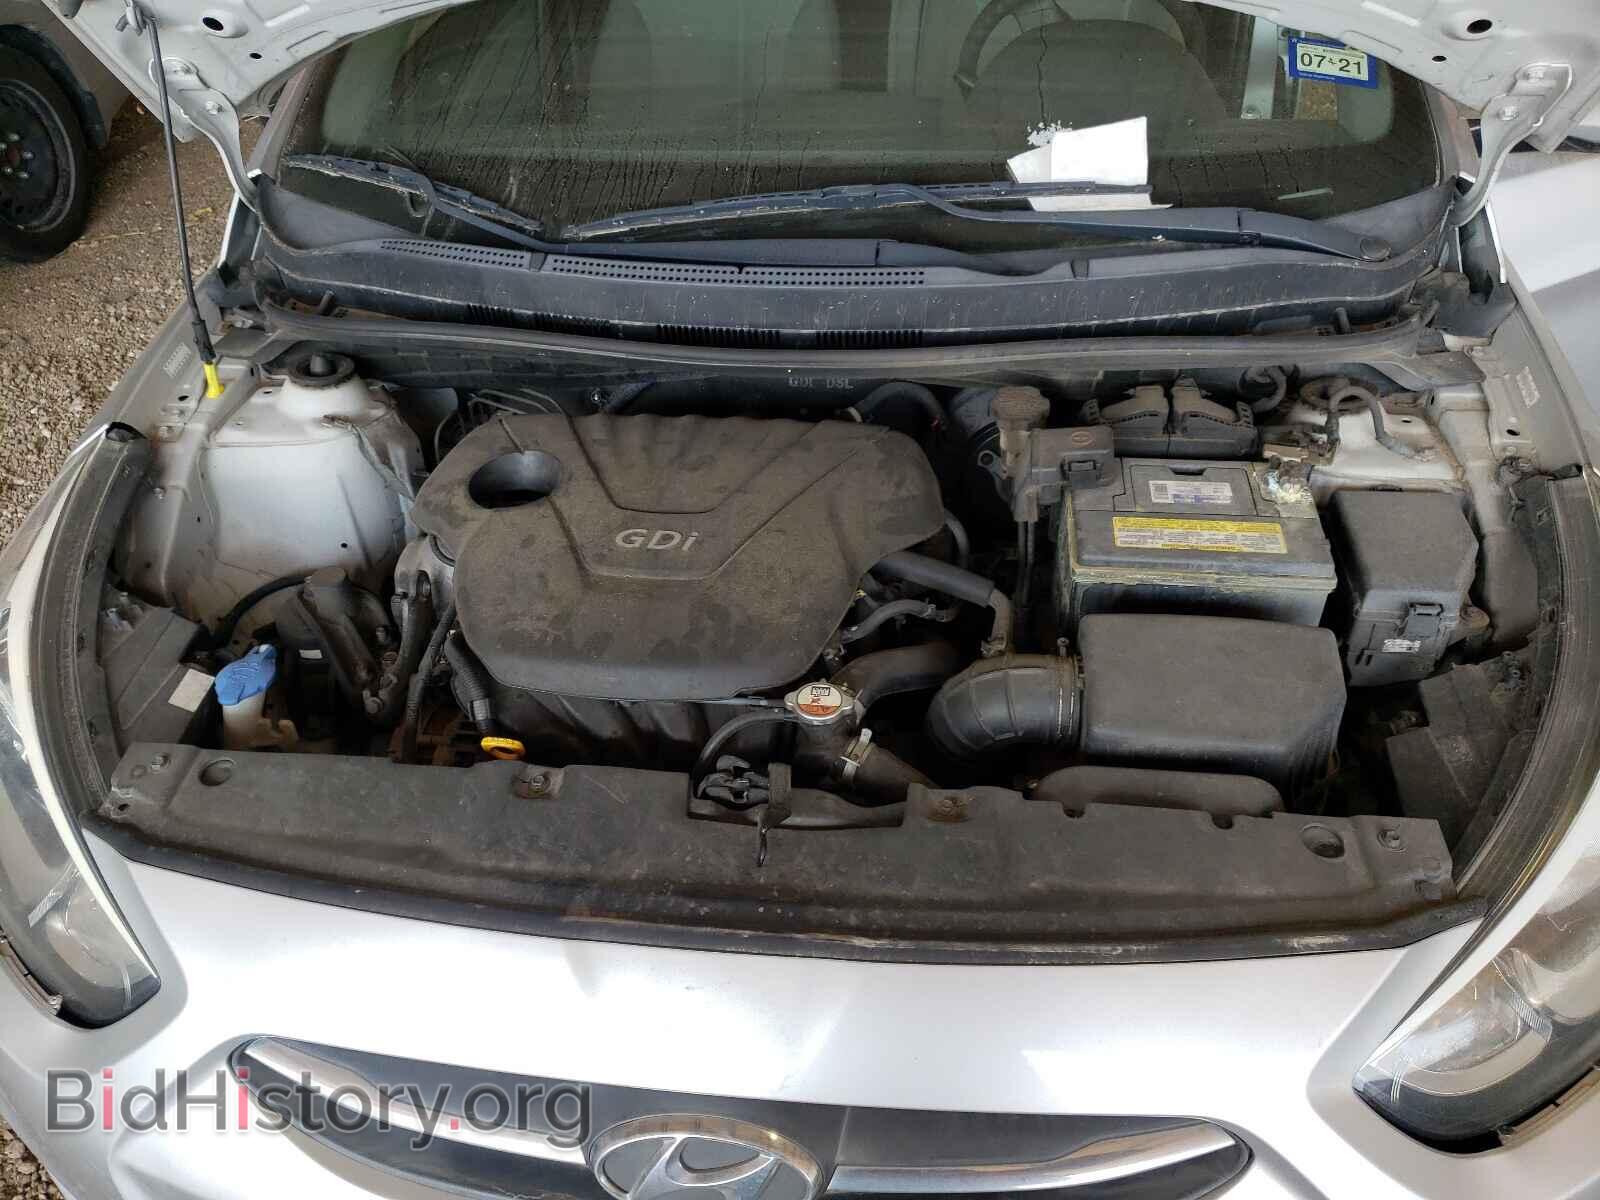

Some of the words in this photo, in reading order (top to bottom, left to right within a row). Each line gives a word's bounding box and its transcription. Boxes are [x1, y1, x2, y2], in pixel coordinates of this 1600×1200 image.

[1301, 53, 1326, 68] 07
[1338, 58, 1361, 74] 21
[615, 528, 699, 551] GDi
